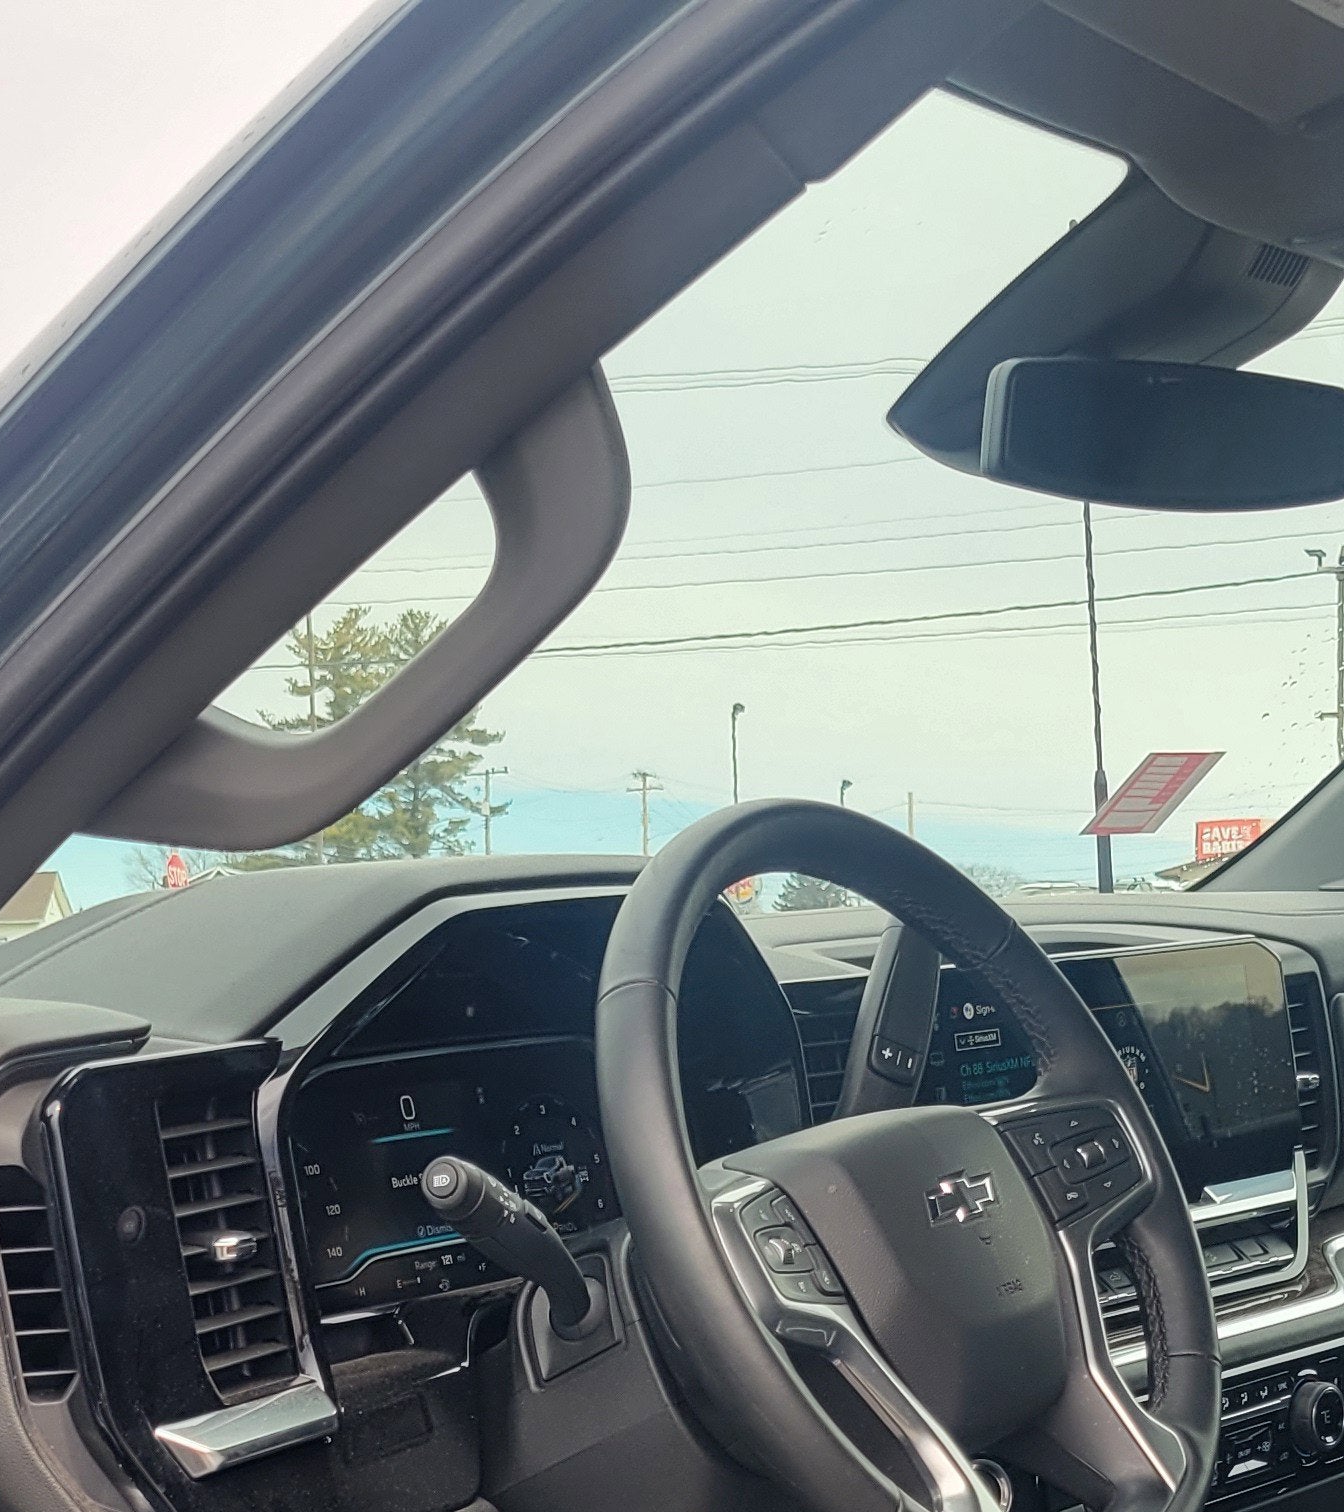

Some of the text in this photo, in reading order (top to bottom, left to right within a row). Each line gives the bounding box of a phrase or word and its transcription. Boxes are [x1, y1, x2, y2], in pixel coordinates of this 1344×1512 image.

[168, 865, 188, 887] STOP
[399, 1094, 416, 1121] 0
[539, 1104, 546, 1115] 3
[403, 1122, 421, 1132] MPH
[570, 1116, 577, 1127] 4
[514, 1125, 521, 1135] 2
[593, 1153, 600, 1164] 5
[304, 1164, 321, 1176] 100
[391, 1173, 419, 1189] Buckle
[597, 1198, 604, 1209] 6
[326, 1204, 341, 1216] 120
[327, 1246, 343, 1258] 140
[441, 1254, 454, 1266] 121
